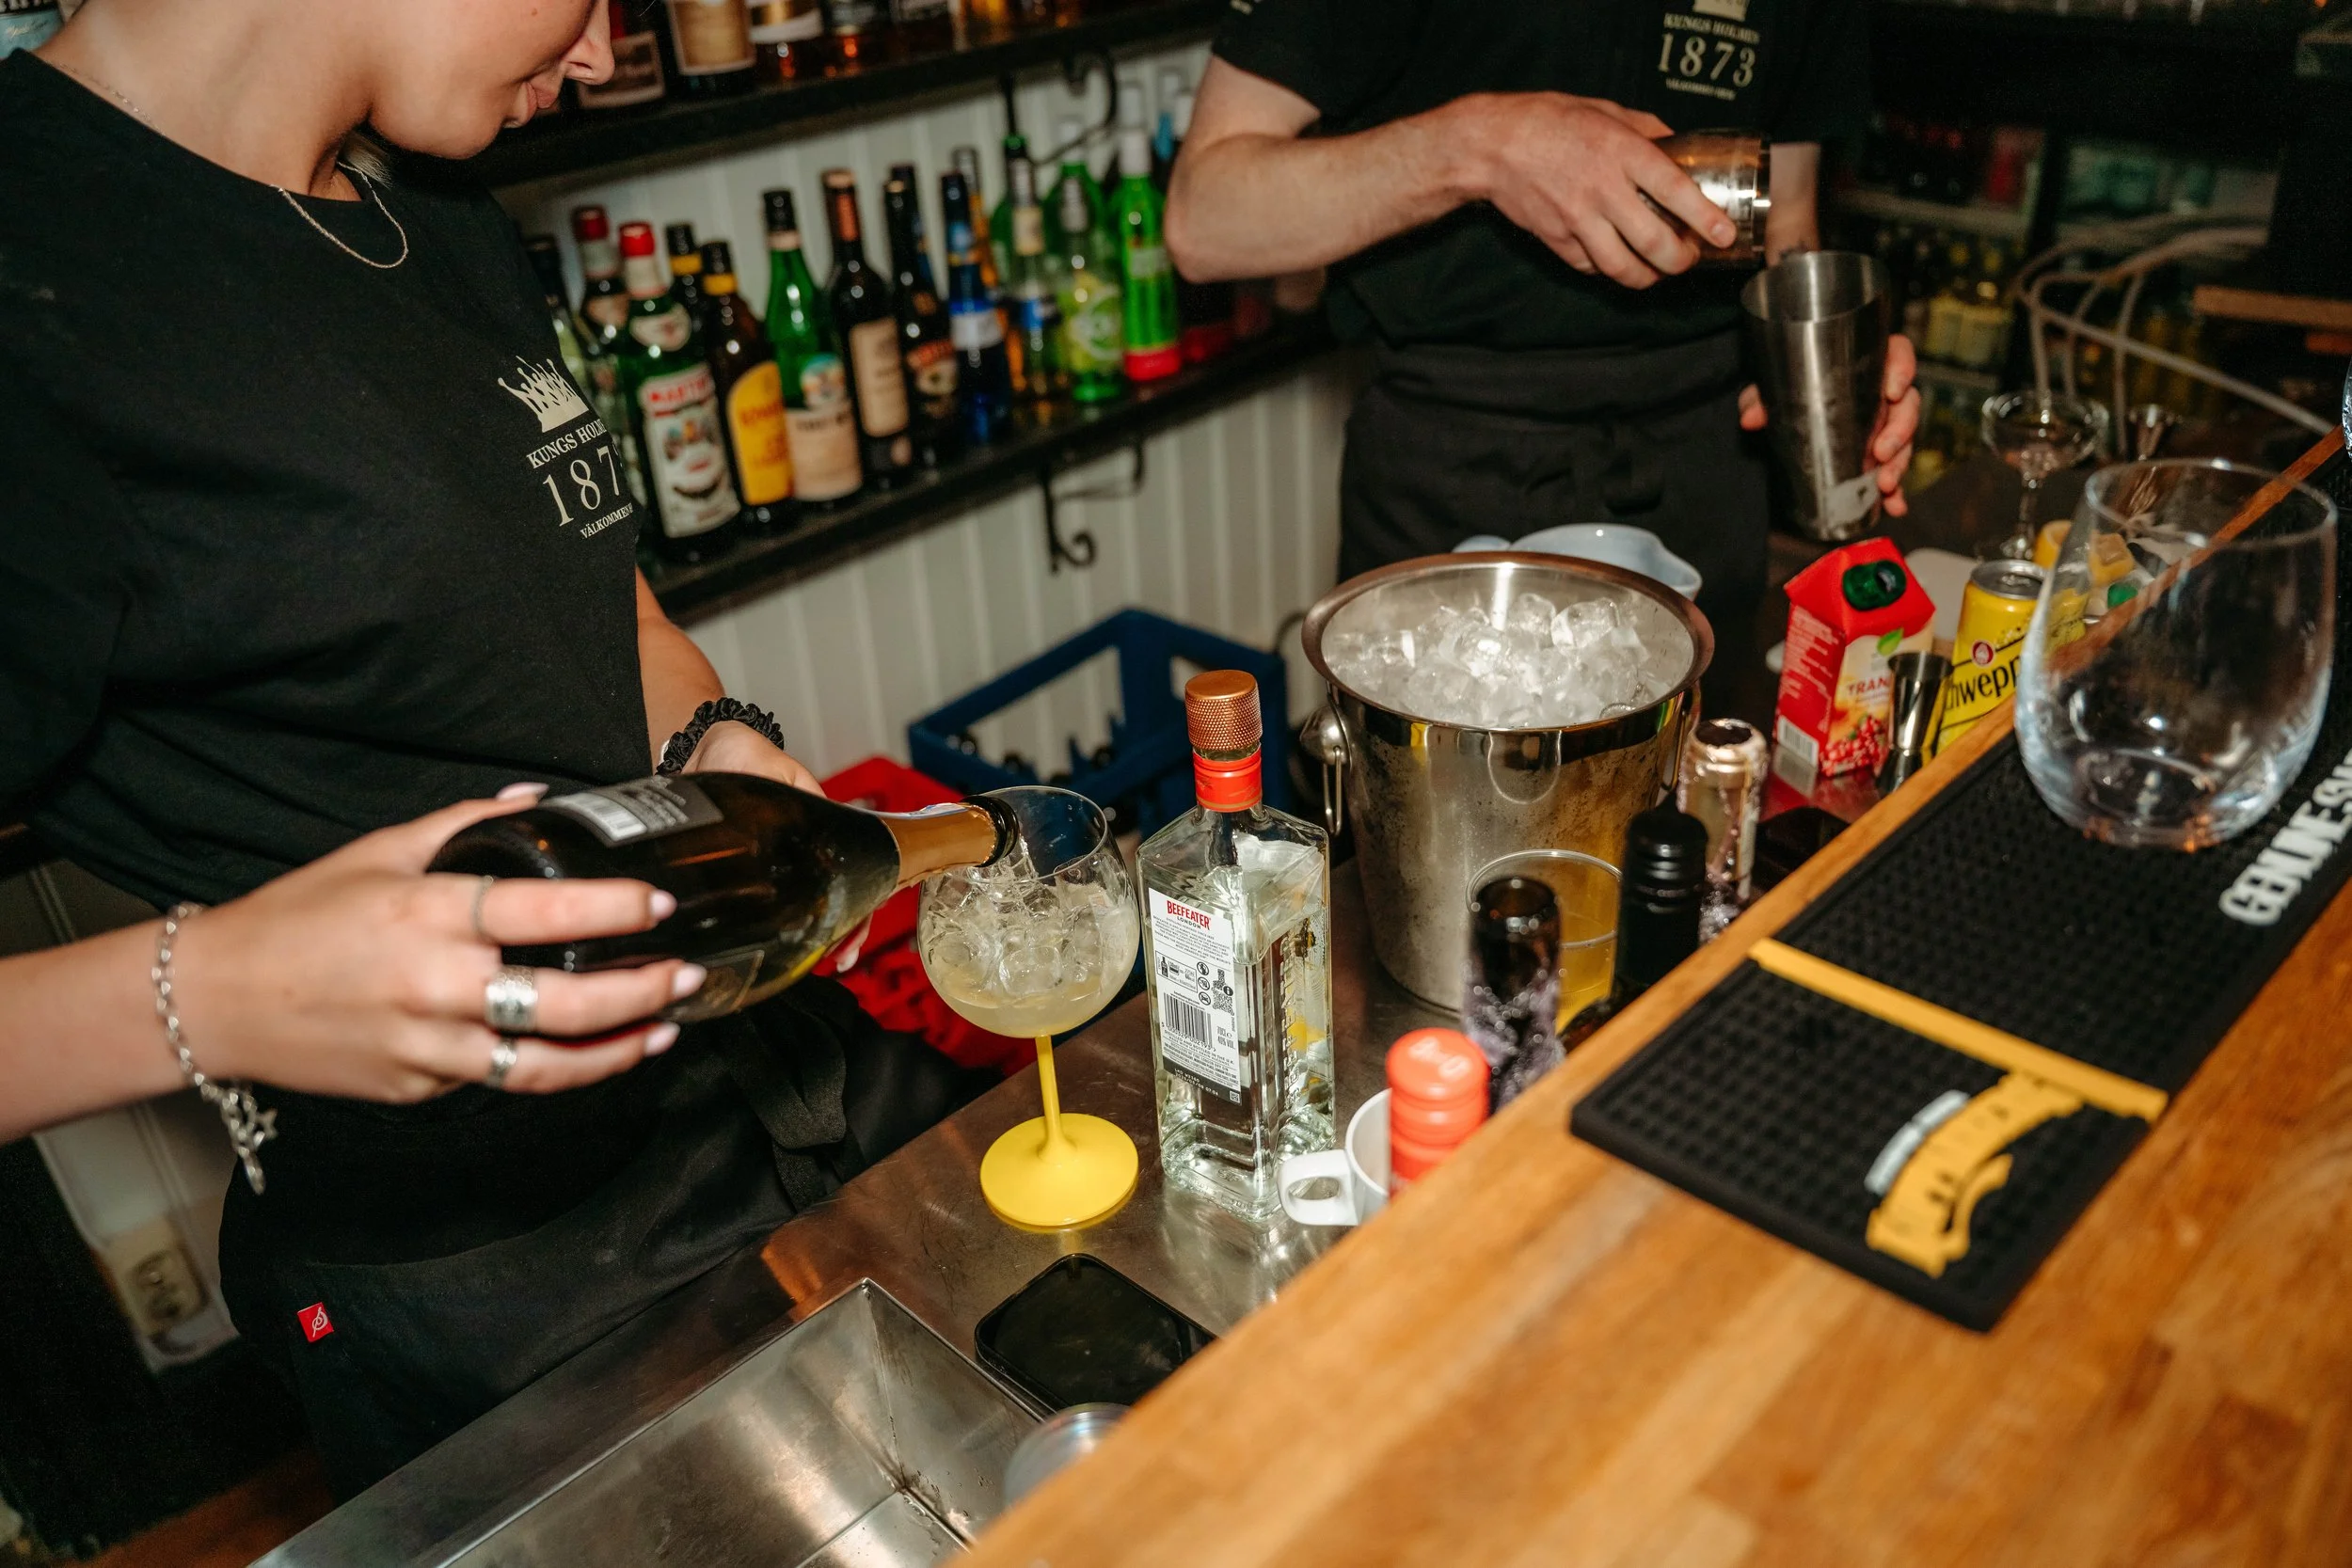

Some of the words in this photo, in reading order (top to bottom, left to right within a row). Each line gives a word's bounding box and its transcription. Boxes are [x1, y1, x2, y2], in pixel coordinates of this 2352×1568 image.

[1658, 32, 1756, 87] 1873
[526, 433, 578, 468] KUNGS
[542, 445, 623, 527] 187
[1847, 675, 1890, 697] TRAN
[1167, 900, 1210, 930] BEEFEATER
[1177, 916, 1201, 929] LONDON
